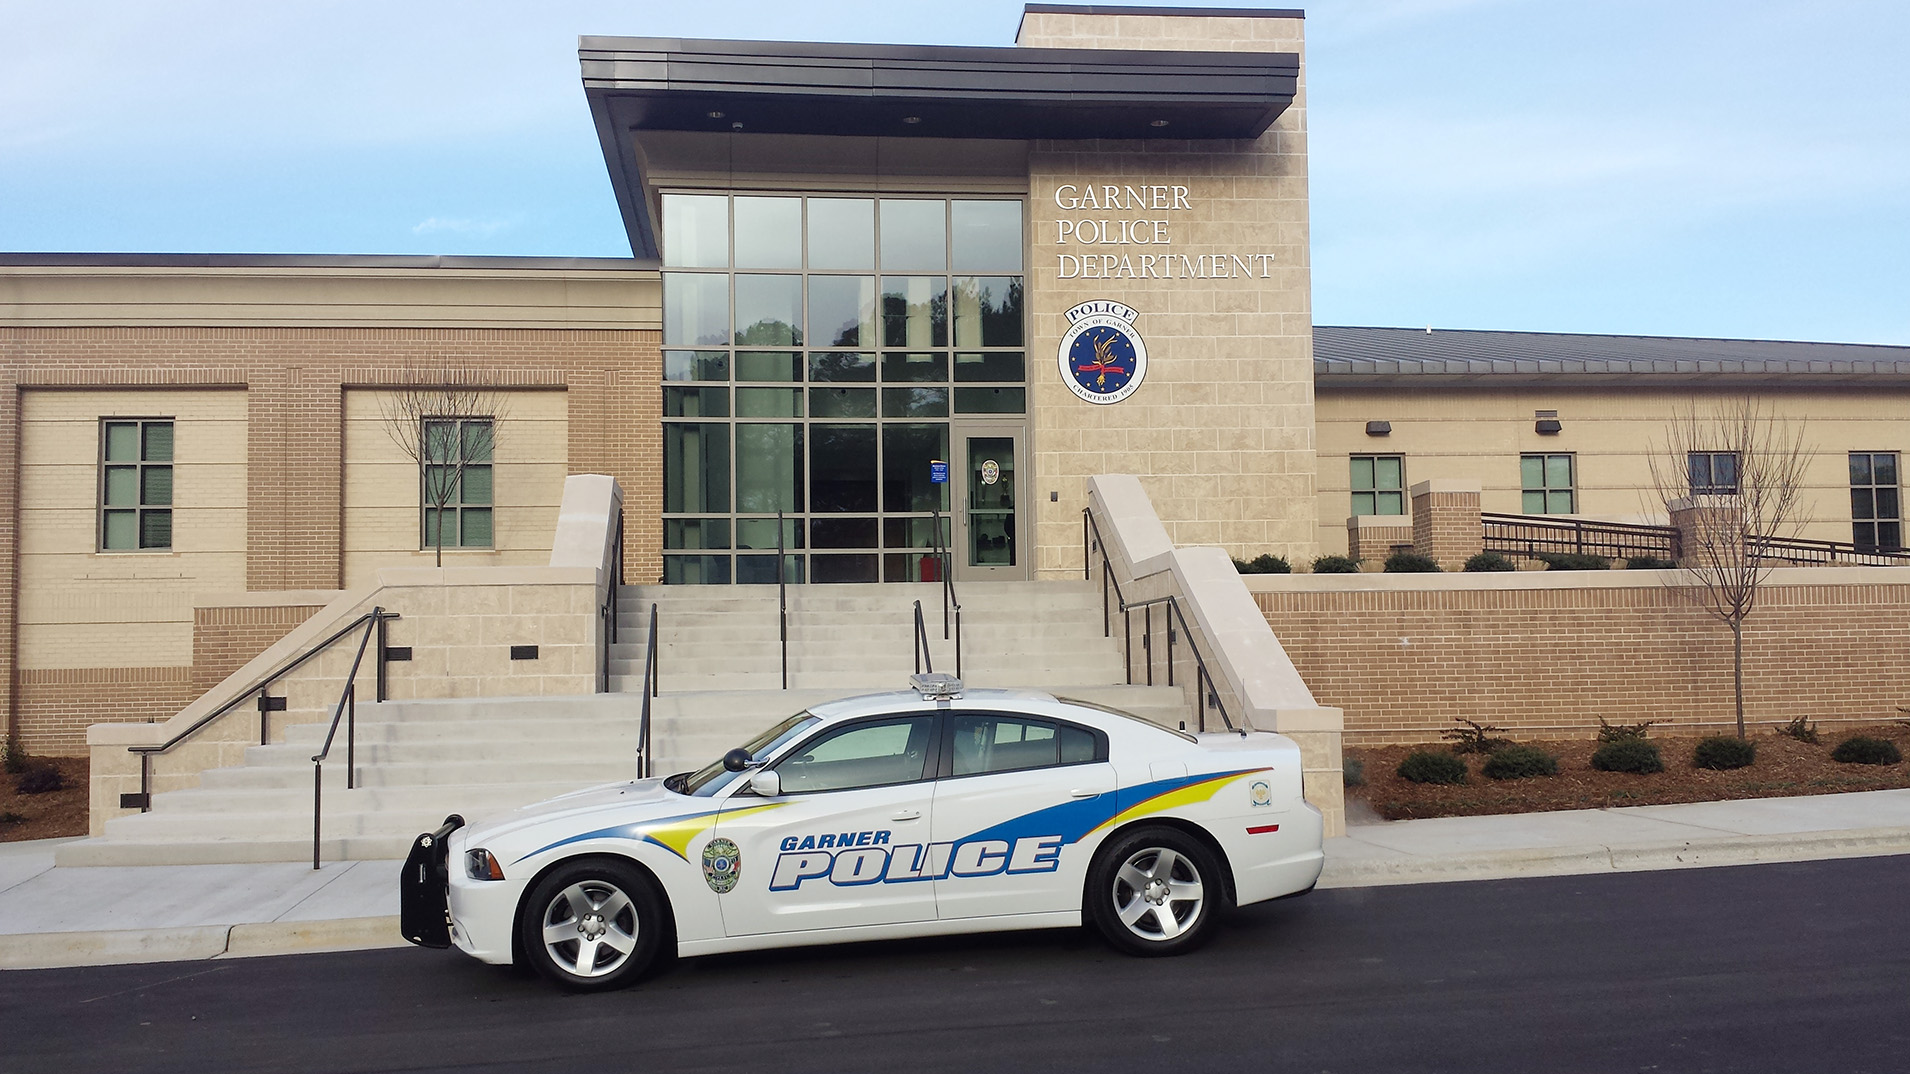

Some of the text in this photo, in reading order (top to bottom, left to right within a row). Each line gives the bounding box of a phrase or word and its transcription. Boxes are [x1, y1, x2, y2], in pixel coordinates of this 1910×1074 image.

[1054, 184, 1192, 210] GARNER
[1055, 219, 1171, 244] POLICE
[1057, 253, 1275, 279] DEPARTMENT
[1069, 303, 1134, 321] POLICE
[1069, 321, 1089, 338] TOWN
[1106, 319, 1135, 339] GARNER
[1072, 384, 1118, 401] CHARTERED
[779, 830, 891, 851] GARNER
[768, 835, 1062, 892] POLICE
